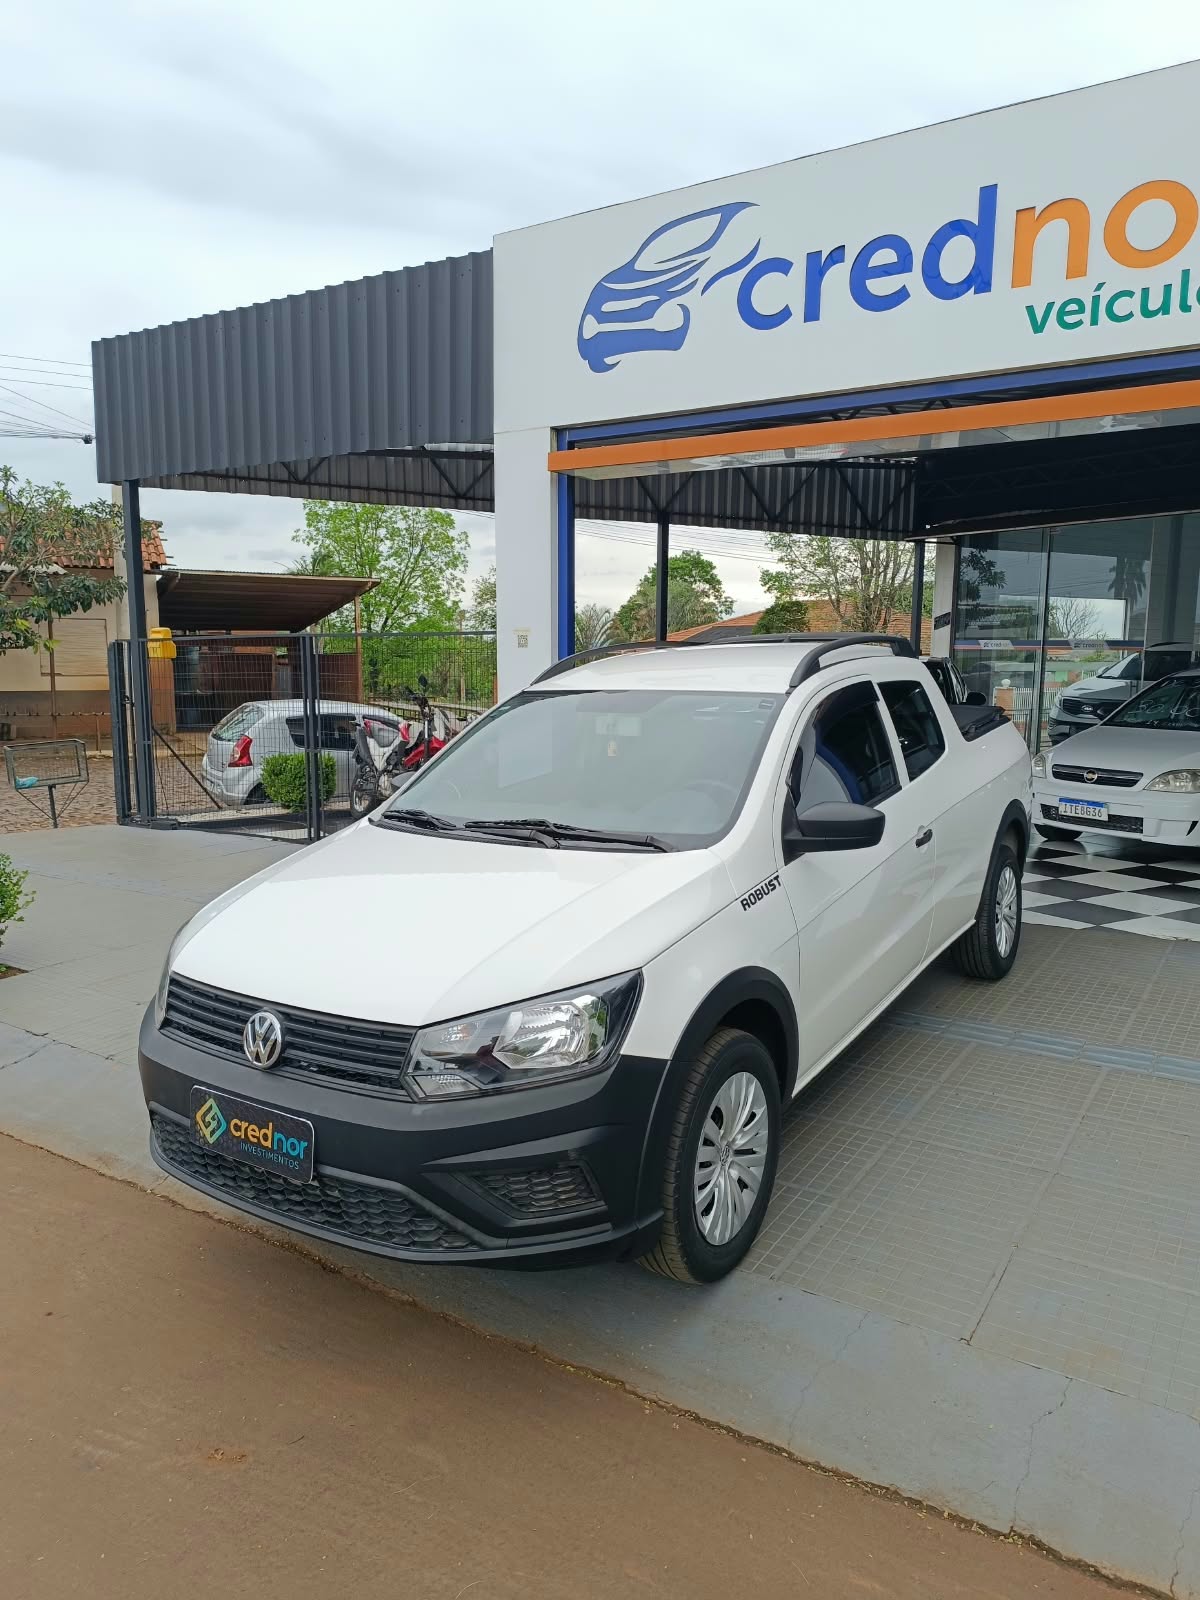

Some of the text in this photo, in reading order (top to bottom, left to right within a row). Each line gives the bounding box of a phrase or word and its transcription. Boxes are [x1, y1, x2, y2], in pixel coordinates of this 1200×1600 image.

[1024, 268, 1200, 335] veícul
[740, 874, 782, 912] ROBUST
[229, 1117, 309, 1160] crednor
[240, 1141, 300, 1170] INVESTIMENTOS
